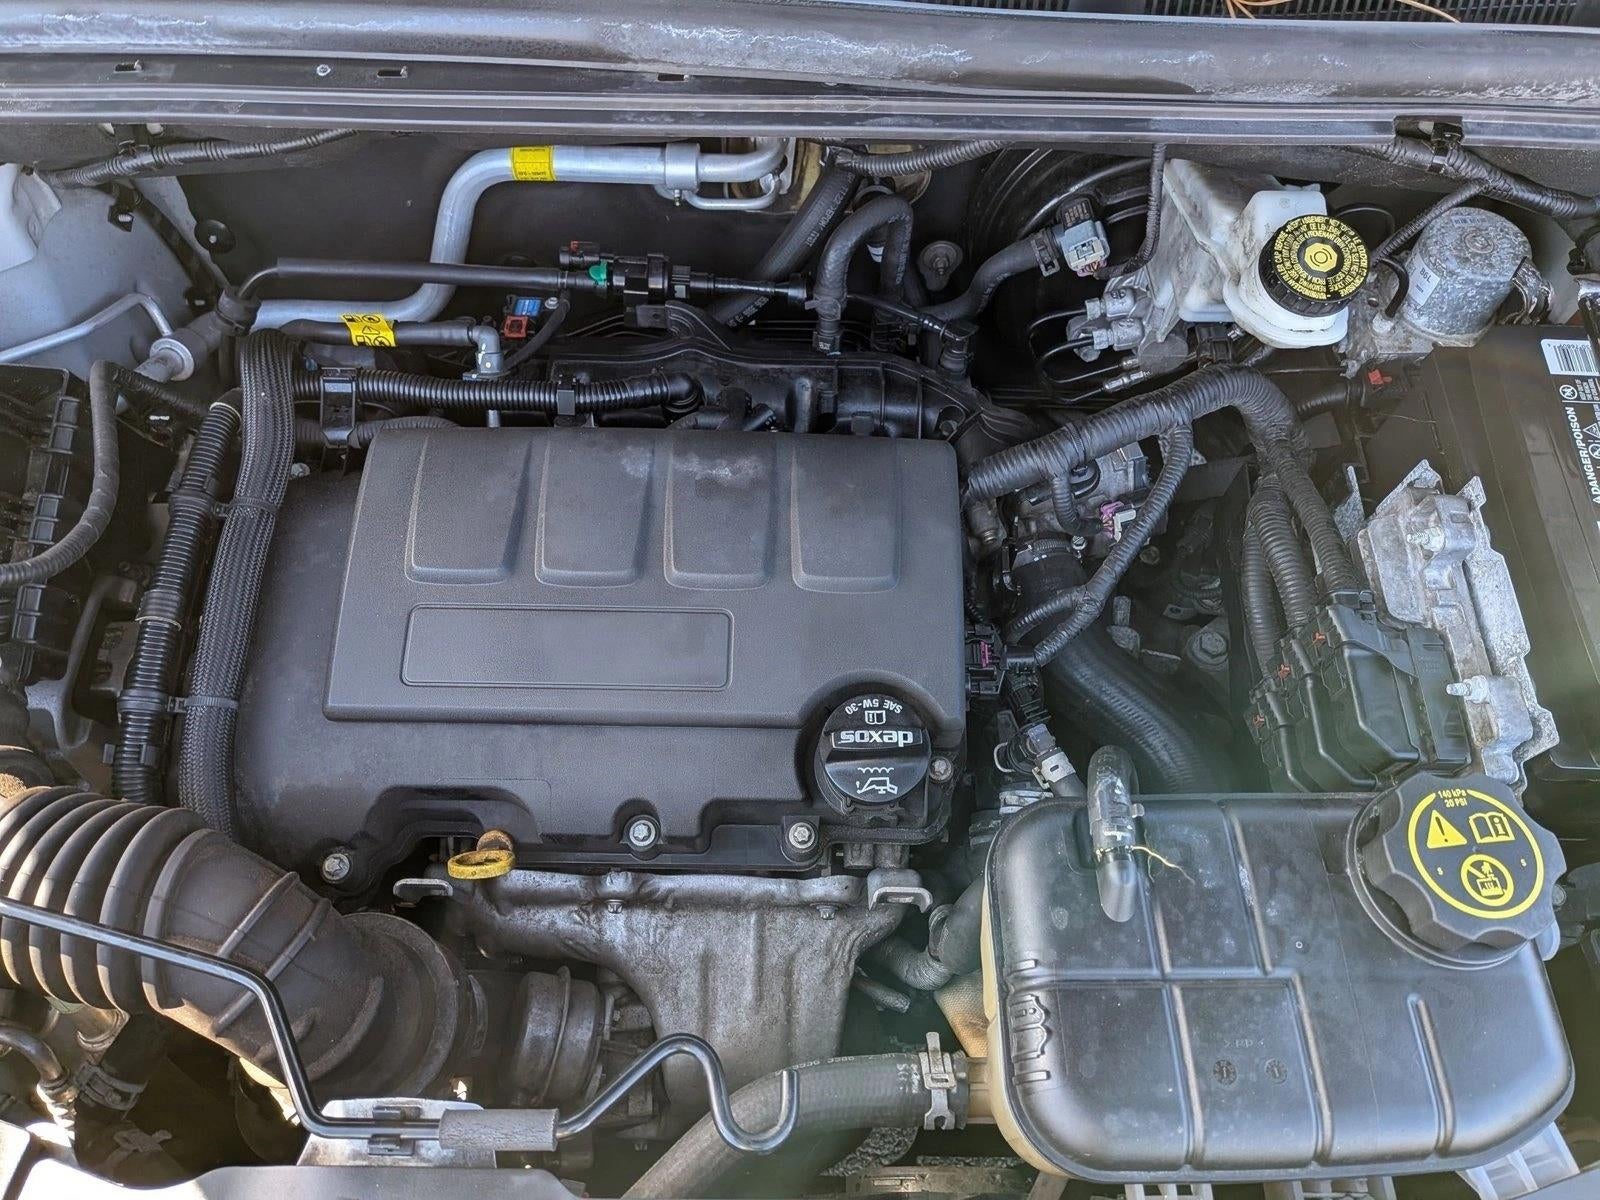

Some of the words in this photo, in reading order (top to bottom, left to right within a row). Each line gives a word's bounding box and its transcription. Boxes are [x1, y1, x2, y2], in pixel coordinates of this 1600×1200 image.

[1565, 406, 1600, 495] DANGER/POISON
[845, 698, 880, 715] 5W-30
[883, 699, 903, 714] SAE
[838, 730, 914, 747] dexos
[1437, 789, 1452, 799] 140
[1452, 788, 1467, 798] kPa
[1444, 799, 1456, 808] 20
[1456, 797, 1468, 807] PSI
